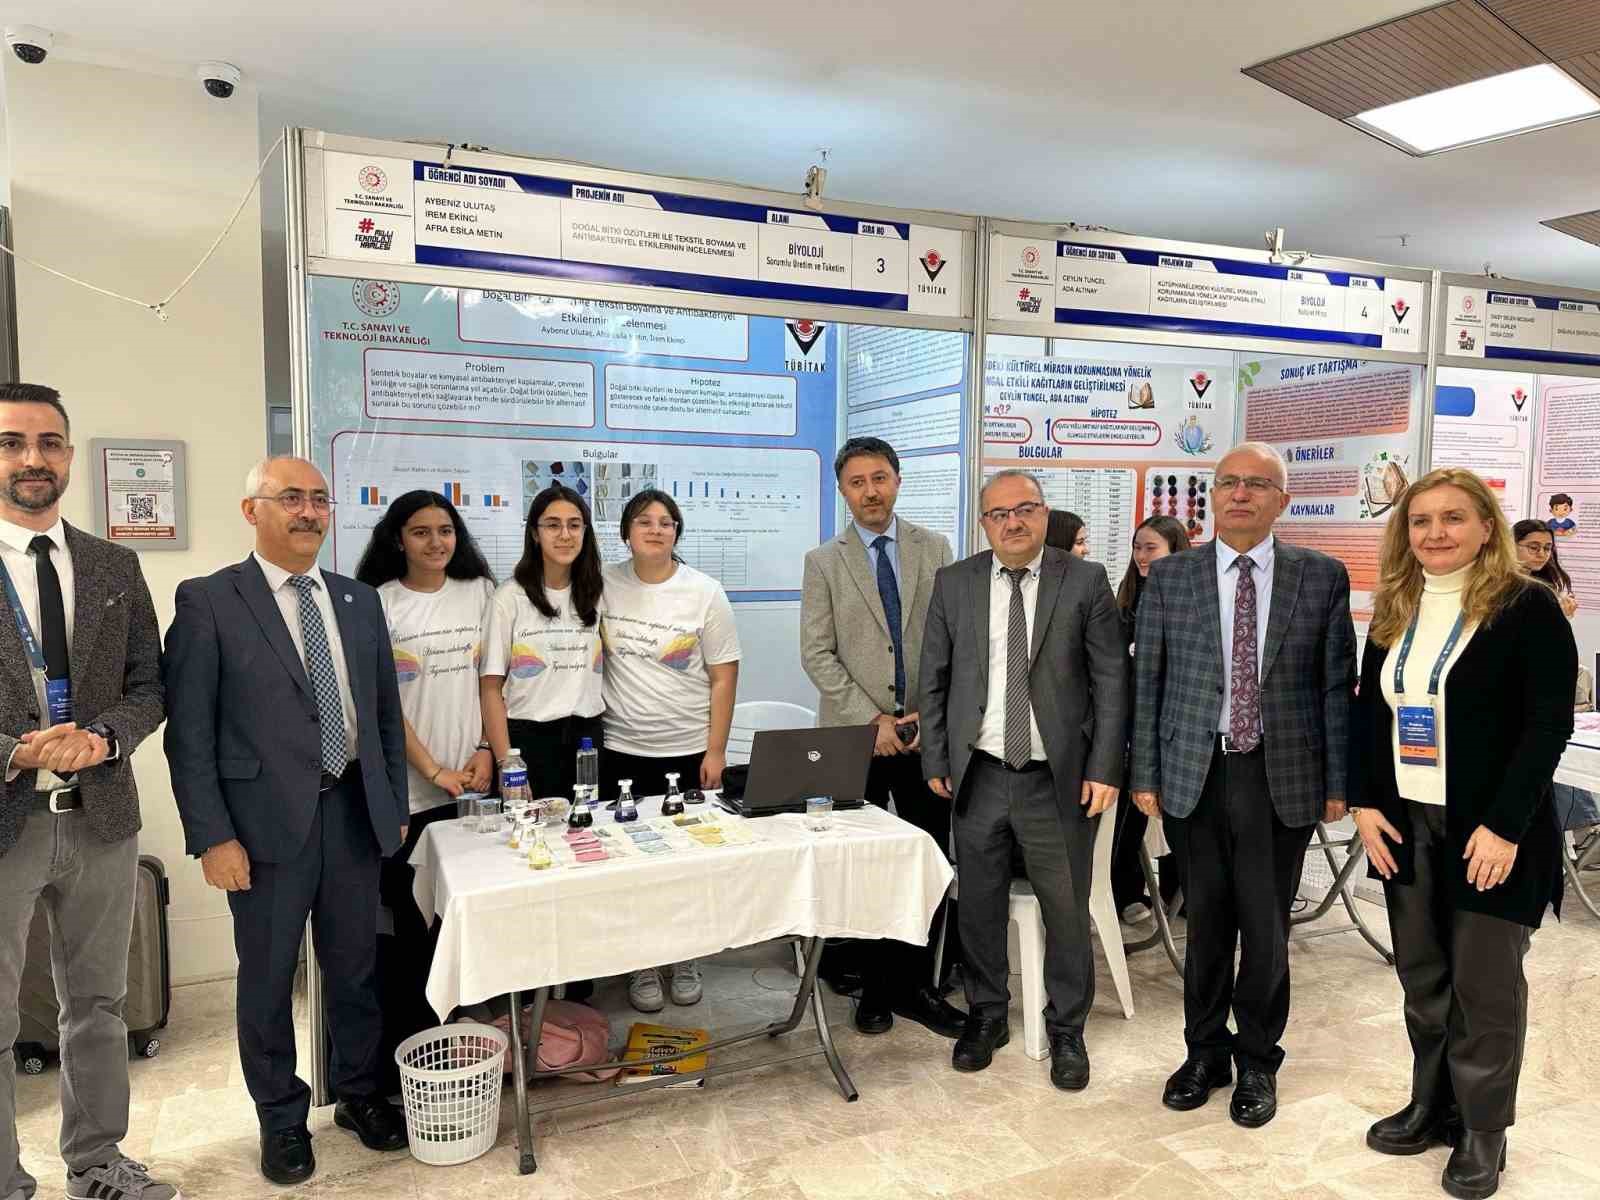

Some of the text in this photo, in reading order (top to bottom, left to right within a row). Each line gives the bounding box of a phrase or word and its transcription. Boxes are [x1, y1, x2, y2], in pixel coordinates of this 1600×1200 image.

[428, 168, 506, 188] ÖĞRENCİ ADI SOYADI
[576, 188, 625, 204] PROJENİN ADI
[426, 208, 446, 219] İREM
[464, 202, 496, 214] ULUTAŞ
[771, 214, 790, 224] ALANI
[426, 224, 448, 233] AFRA
[450, 226, 474, 236] ESİLA
[675, 234, 704, 246] TEKSTİL
[706, 239, 736, 250] BOYAMA
[738, 242, 747, 250] VE
[788, 242, 824, 258] BİYOLOJİ
[814, 263, 822, 271] ve
[876, 257, 886, 274] 3
[1075, 286, 1098, 295] ALTINAY
[664, 307, 676, 316] ve
[1361, 305, 1368, 318] 4
[342, 322, 411, 334] T.C. SANAYİ VE
[324, 330, 431, 346] TEKNOLOJİ BAKANLIĞI
[465, 362, 505, 374] Problem
[785, 358, 827, 374] TÜBİTAK
[1044, 362, 1072, 375] MİRASIN
[1074, 365, 1122, 378] KORUNMASINA
[1122, 366, 1152, 378] YÖNELİK
[1280, 360, 1359, 382] SONUÇ VE TARTIŞMA
[401, 370, 428, 382] boyalar
[690, 377, 721, 390] Hipotez
[1031, 377, 1072, 390] KAĞITLARIN
[1073, 379, 1126, 394] GELİŞTİRİLMESİ
[1050, 394, 1062, 402] ADA
[1063, 395, 1089, 404] ALTINAY
[1091, 406, 1118, 419] HİPOTEZ
[582, 449, 618, 462] Bulgular
[1018, 446, 1063, 458] BULGULAR
[1296, 446, 1335, 462] ÖNERİLER
[1290, 504, 1335, 516] KAYNAKLAR
